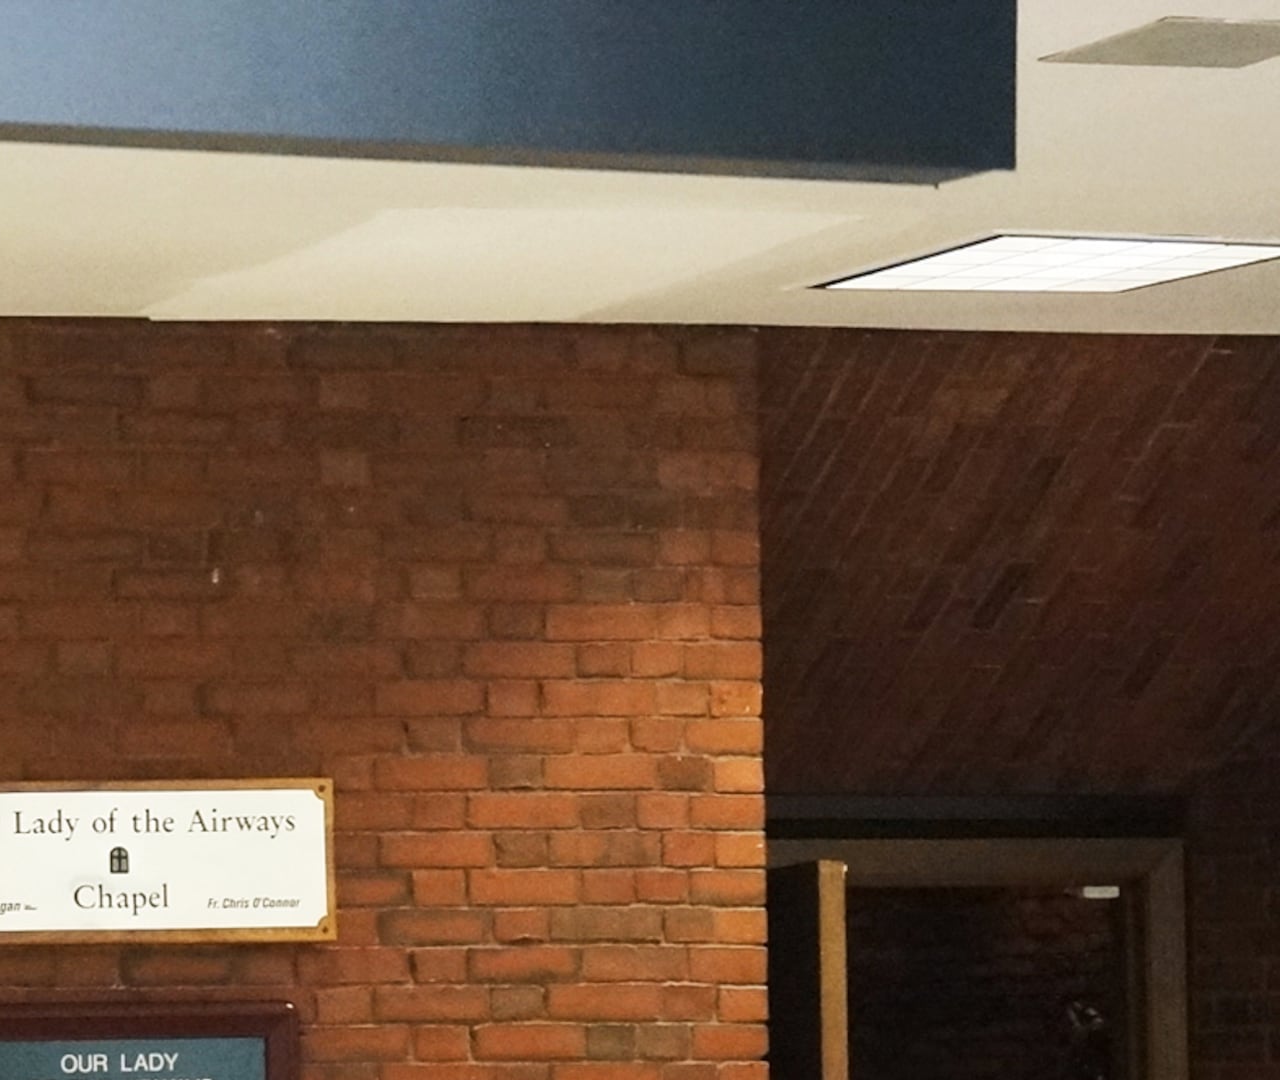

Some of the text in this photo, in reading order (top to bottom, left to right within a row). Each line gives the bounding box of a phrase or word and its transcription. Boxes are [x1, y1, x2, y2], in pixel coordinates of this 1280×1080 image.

[14, 810, 79, 840] Lady
[92, 808, 119, 833] of
[132, 809, 175, 833] the
[187, 809, 296, 839] Airways
[73, 884, 170, 915] Chapel
[222, 897, 250, 909] Chris
[61, 1052, 180, 1073] OUR LADY
